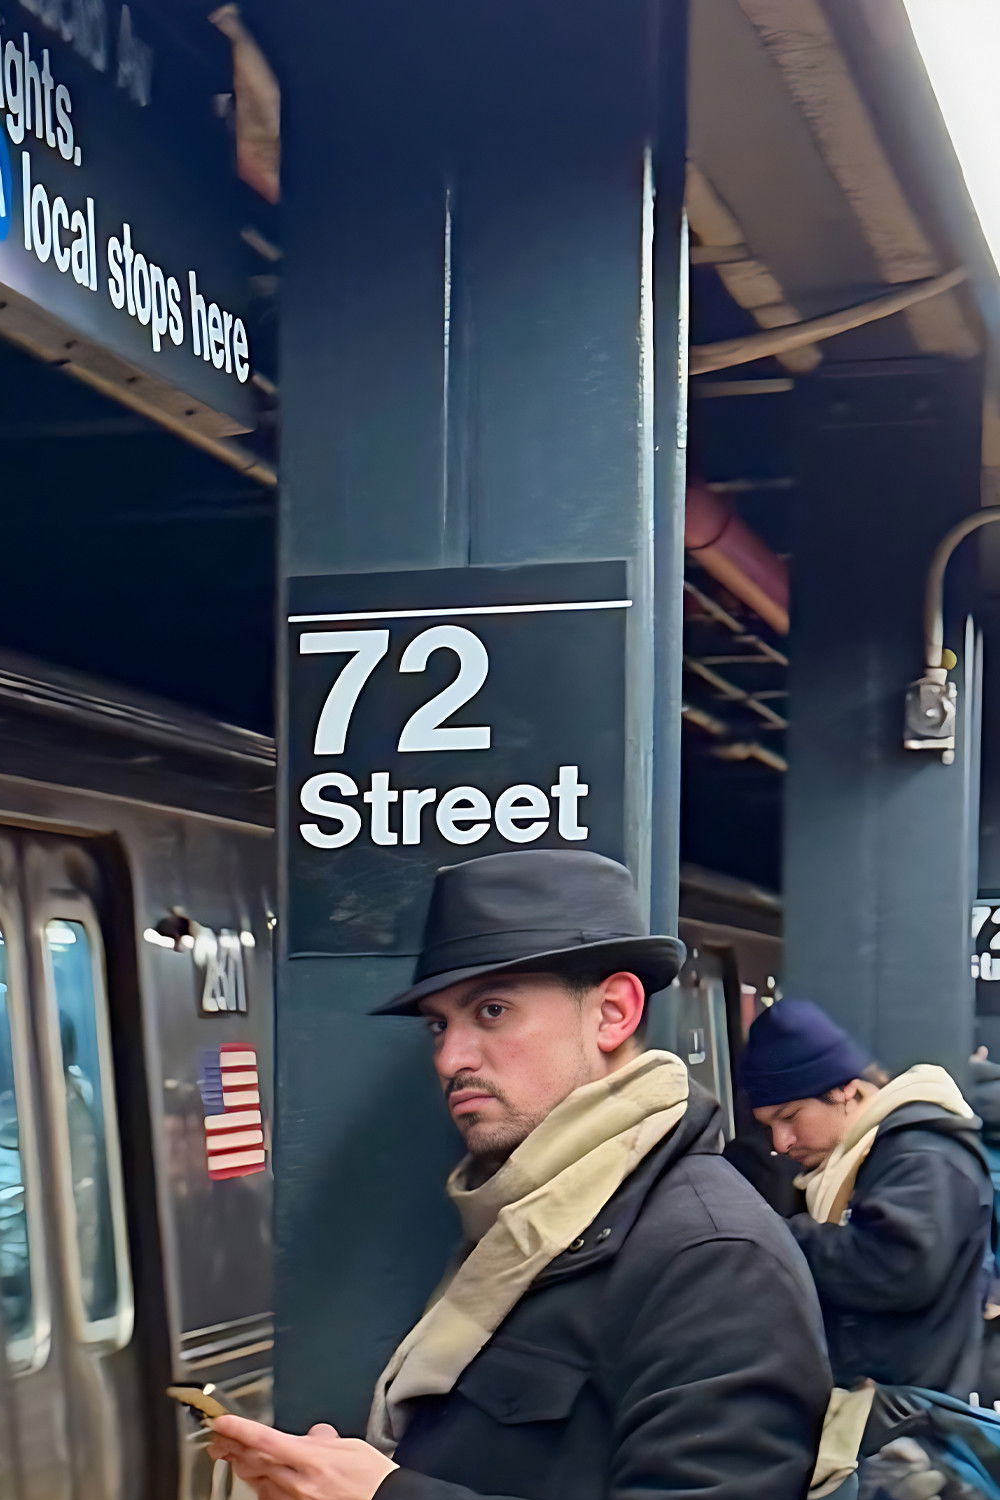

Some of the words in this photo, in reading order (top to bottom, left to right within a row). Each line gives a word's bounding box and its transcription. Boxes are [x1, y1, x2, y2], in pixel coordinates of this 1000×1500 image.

[21, 151, 98, 292] local
[107, 222, 184, 353] stops
[187, 270, 250, 384] here
[299, 624, 491, 756] 72
[299, 765, 589, 849] Street
